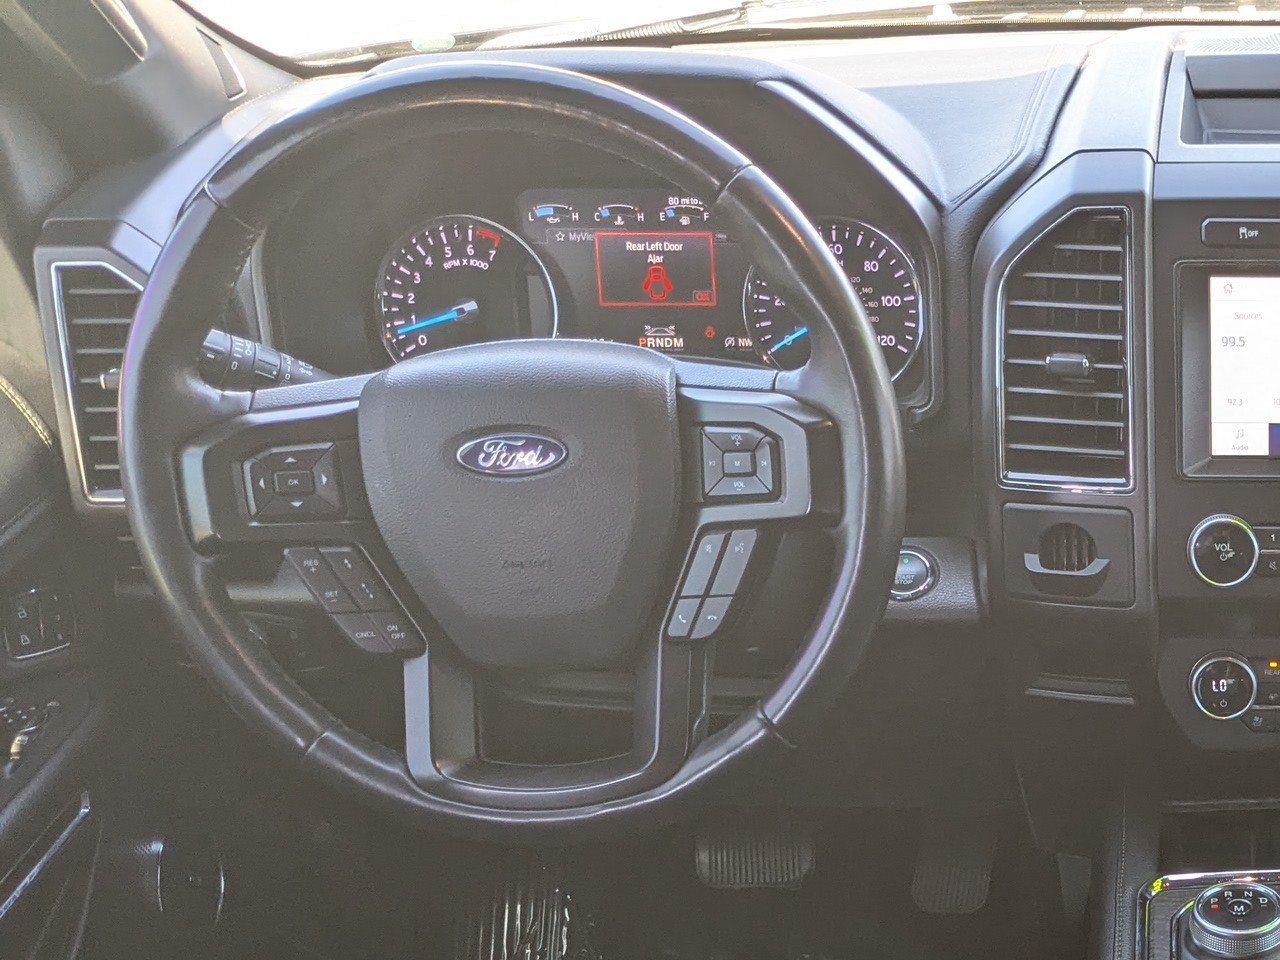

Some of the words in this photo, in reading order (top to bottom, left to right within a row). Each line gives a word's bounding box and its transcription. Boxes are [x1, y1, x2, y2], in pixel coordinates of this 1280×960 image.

[668, 197, 679, 205] 80
[680, 197, 689, 205] mi
[528, 213, 534, 222] L
[571, 213, 579, 221] H
[594, 213, 600, 221] C
[637, 213, 645, 221] H
[659, 213, 666, 221] E
[703, 213, 709, 221] F
[569, 233, 594, 242] MyVie
[466, 245, 475, 256] 6
[626, 241, 645, 251] Rear
[646, 241, 662, 251] Left
[664, 241, 683, 251] Door
[829, 244, 843, 254] 60
[445, 247, 452, 258] 5
[489, 250, 496, 261] 7
[425, 256, 433, 267] 4
[647, 254, 664, 263] Ajar
[443, 259, 461, 270] RPM
[470, 259, 489, 270] 1000
[864, 261, 879, 272] 80
[414, 272, 421, 284] 3
[407, 293, 415, 304] 2
[881, 296, 901, 307] 100
[1234, 311, 1263, 321] Sources
[418, 335, 427, 345] 0
[638, 338, 684, 348] PRNDM
[738, 338, 753, 347] NW
[1221, 336, 1246, 348] 99.5
[478, 440, 556, 470] Ford
[1270, 533, 1276, 542] 1
[1214, 543, 1233, 552] VOL
[387, 624, 399, 632] ON
[391, 632, 405, 640] OFF
[1212, 678, 1228, 692] LO
[1224, 890, 1233, 898] R
[1244, 890, 1253, 898] N
[1233, 904, 1245, 912] M
